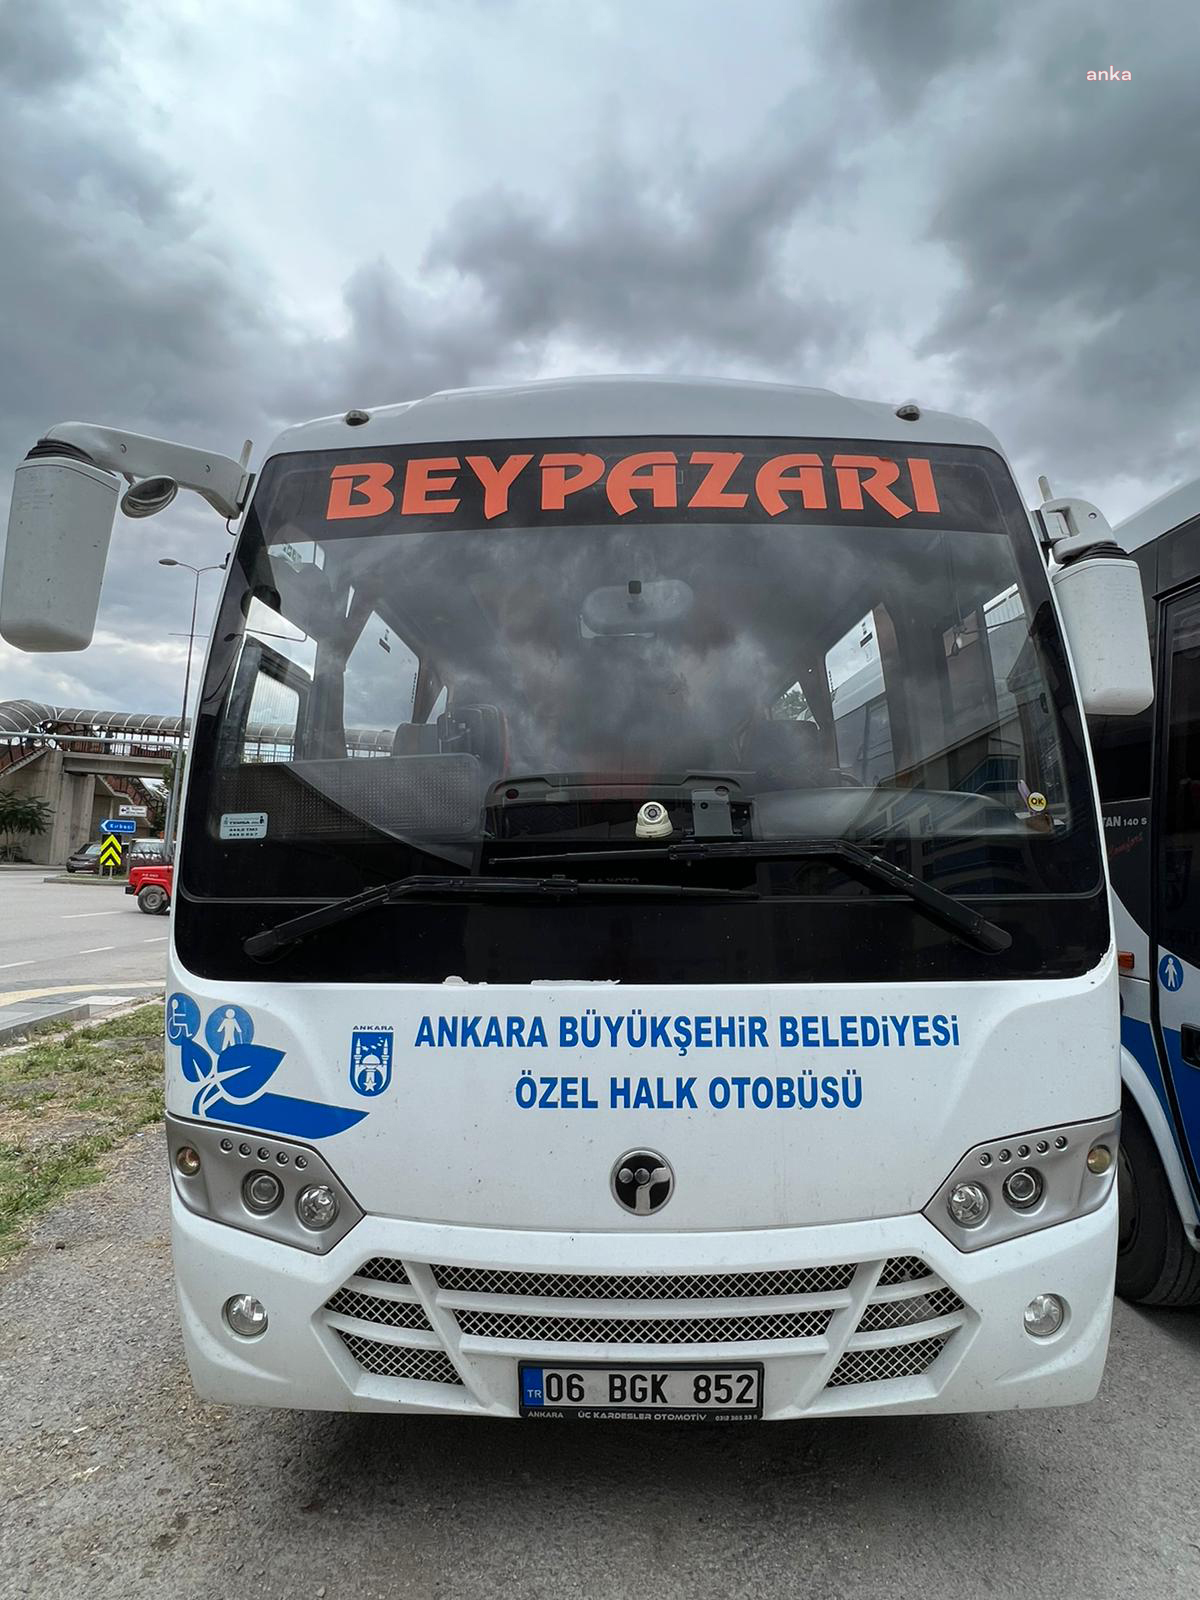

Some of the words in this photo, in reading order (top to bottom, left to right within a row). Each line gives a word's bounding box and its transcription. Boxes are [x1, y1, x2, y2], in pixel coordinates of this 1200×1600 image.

[327, 452, 939, 519] BEYPAZARI
[1030, 797, 1044, 805] OK
[1123, 818, 1139, 827] 140
[415, 1016, 548, 1048] ANKARA
[515, 1070, 599, 1110] ÖZEL
[609, 1076, 698, 1110] HALK
[708, 1069, 863, 1110] OTOBÜSÜ
[527, 1389, 541, 1399] TR
[545, 1373, 585, 1403] 06
[608, 1373, 669, 1404] BGK
[693, 1374, 754, 1404] 852
